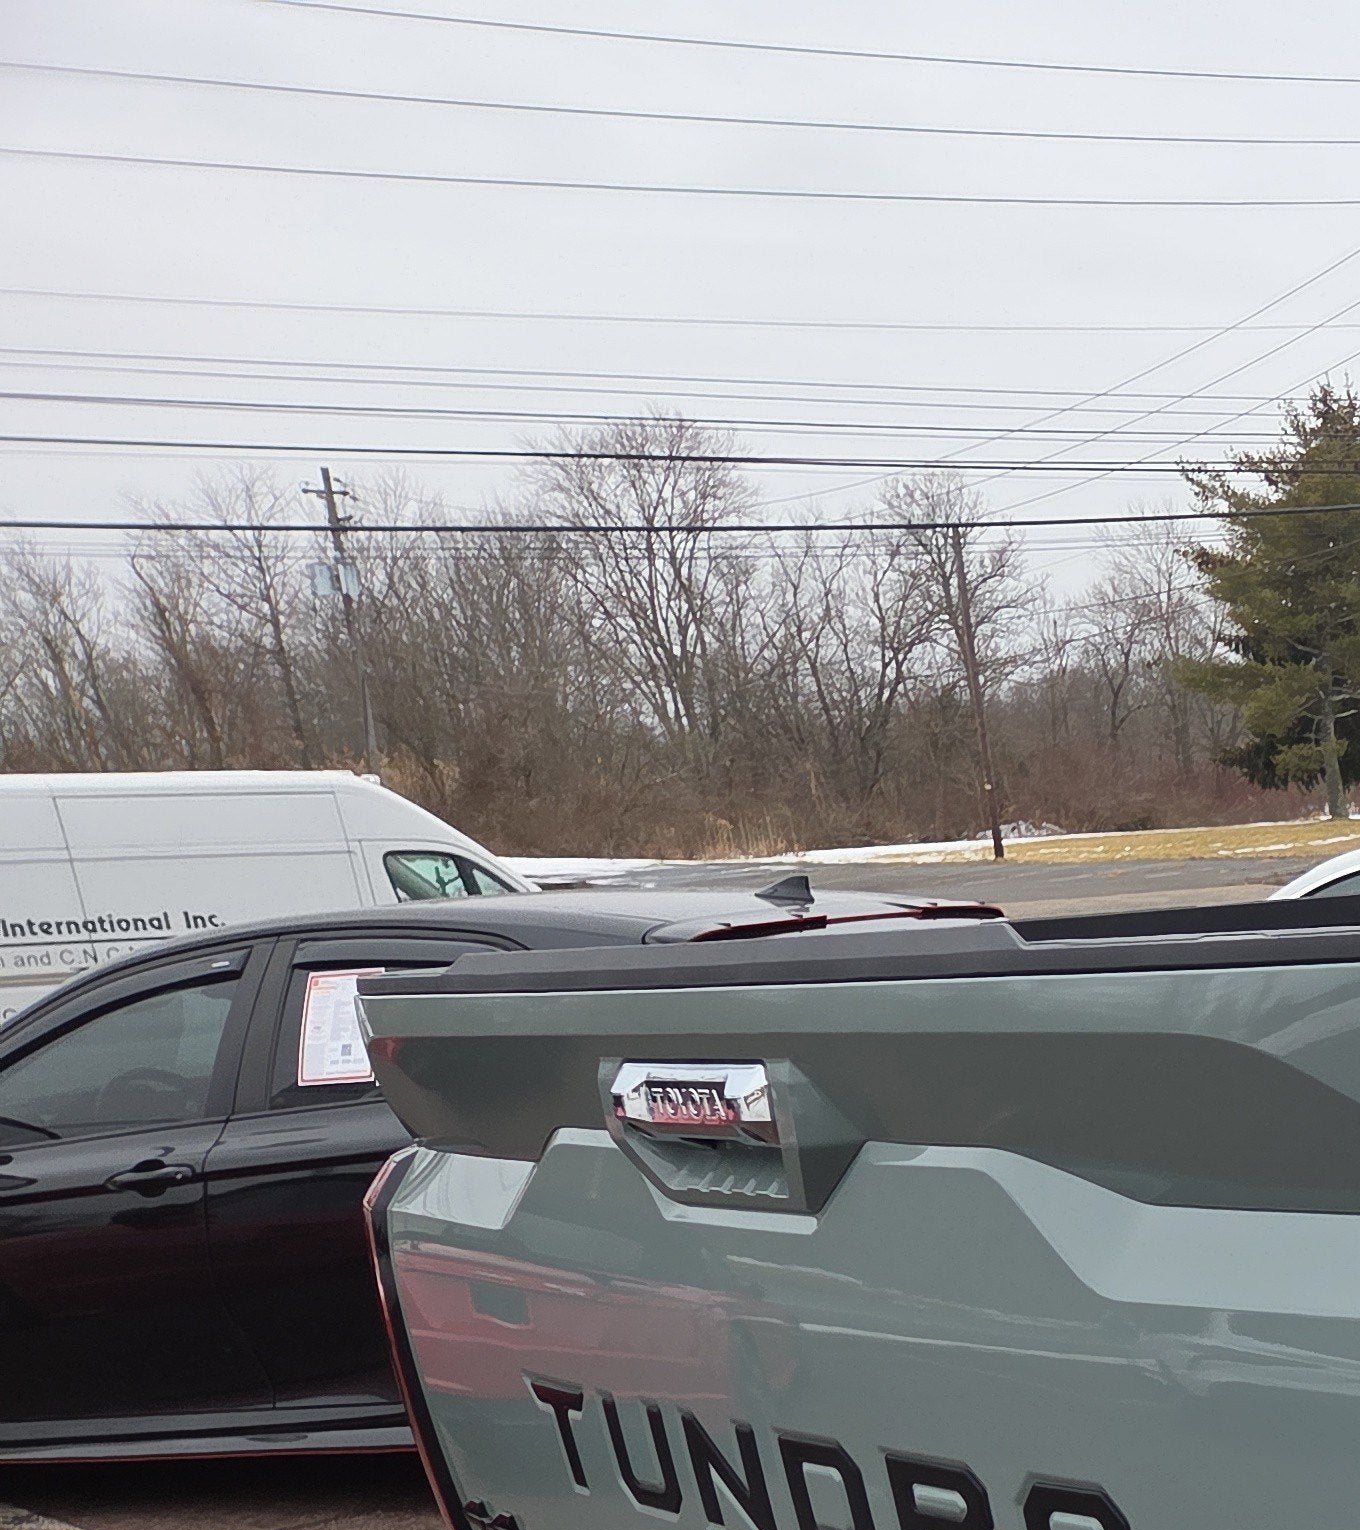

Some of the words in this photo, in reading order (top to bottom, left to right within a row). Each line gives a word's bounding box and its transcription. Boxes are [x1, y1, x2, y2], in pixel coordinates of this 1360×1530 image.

[1, 911, 171, 938] International
[183, 911, 226, 930] Inc.
[13, 951, 50, 968] and
